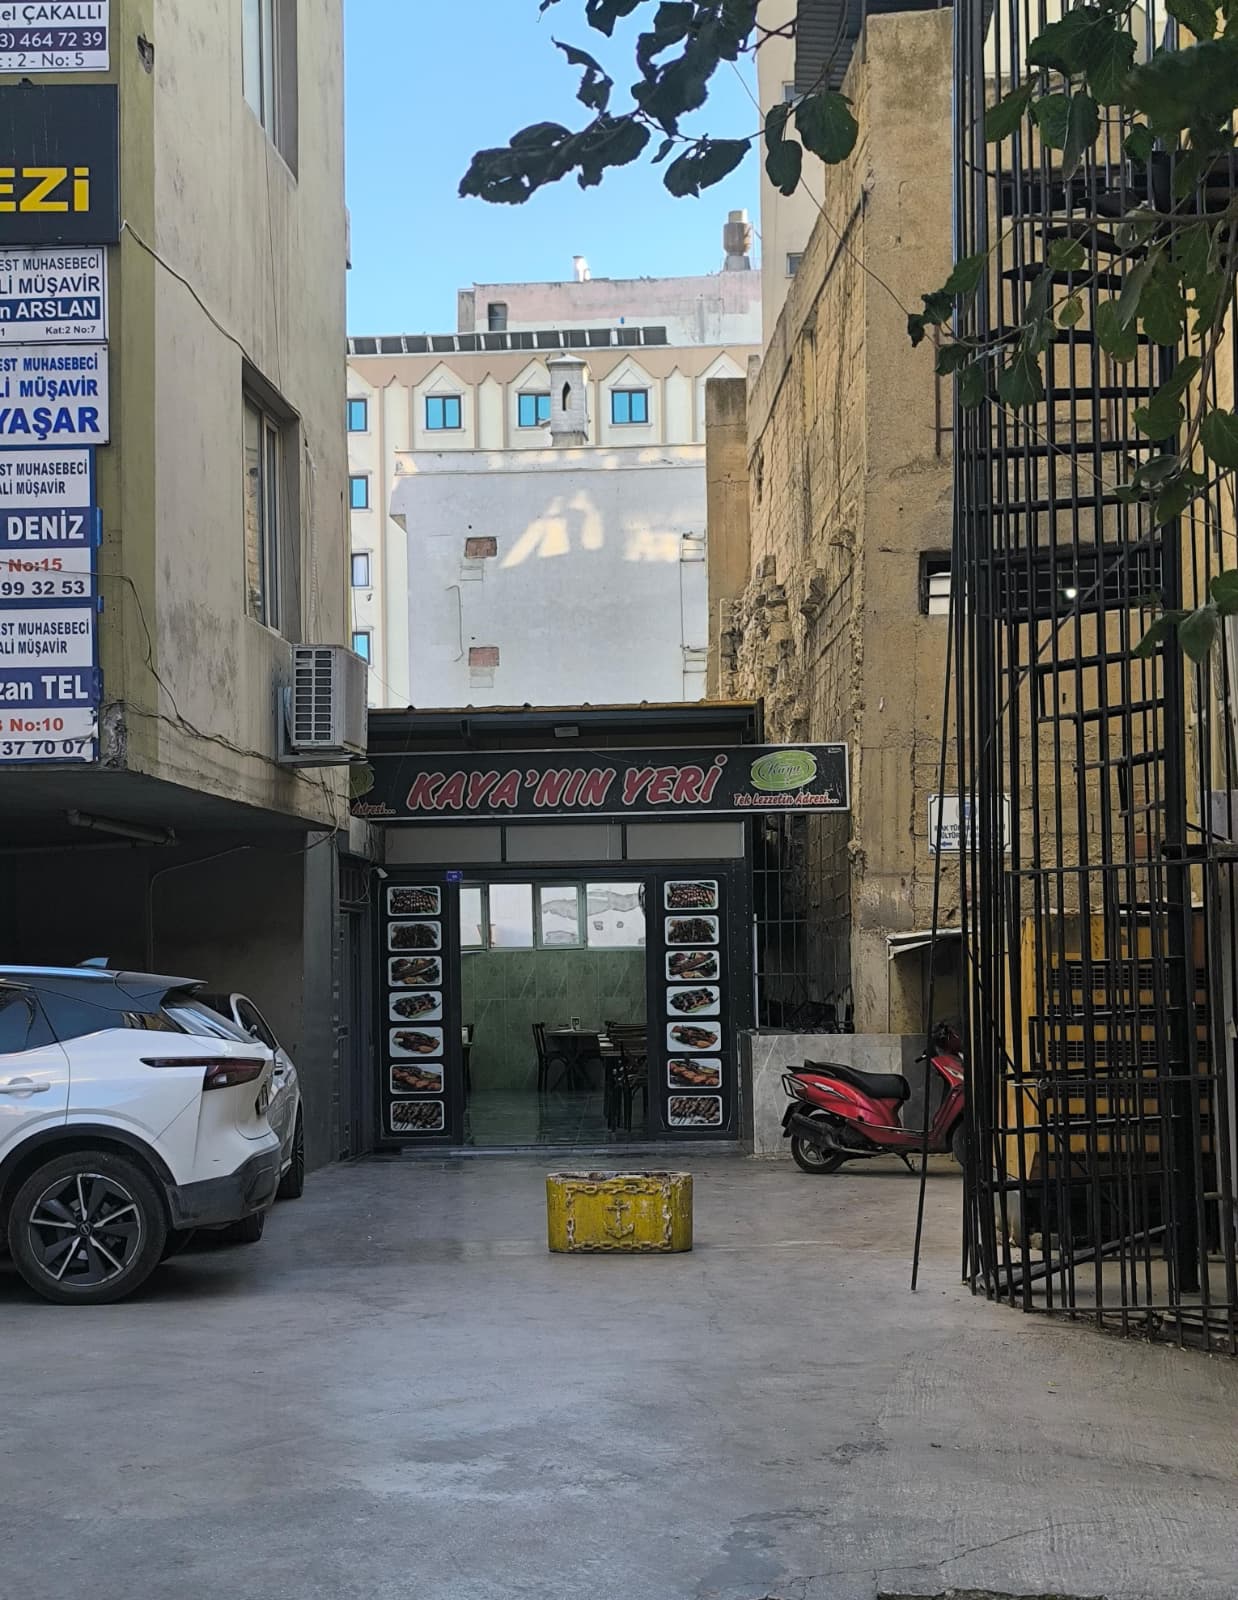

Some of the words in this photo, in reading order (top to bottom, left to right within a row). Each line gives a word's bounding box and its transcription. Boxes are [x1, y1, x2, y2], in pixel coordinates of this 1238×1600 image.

[22, 4, 102, 26] ÇAKALLI
[19, 32, 54, 47] 464
[58, 32, 77, 47] 72
[82, 31, 103, 47] 39
[22, 253, 99, 271] MUHASEBECİ
[19, 272, 101, 297] MÜŞAVİR
[16, 300, 96, 319] ARSLAN
[45, 325, 71, 335] Kat:2
[73, 325, 96, 335] No:7
[23, 352, 98, 371] MUHASEBECİ
[19, 374, 98, 402] MÜŞAVİR
[16, 458, 88, 477] MUHASEBECİ
[16, 477, 66, 498] MÜŞAVİR
[7, 509, 85, 541] DENİZ
[8, 557, 63, 573] No:15
[1, 581, 25, 596] 99
[31, 580, 55, 595] 32
[61, 580, 85, 595] 53
[18, 618, 89, 636] MUHASEBECİ
[18, 637, 68, 657] MÜŞAVİR
[41, 675, 89, 700] TEL
[10, 717, 64, 732] No:10
[2, 741, 26, 756] 37
[32, 740, 56, 755] 70
[62, 740, 86, 754] 07
[622, 753, 728, 805] YERİ
[733, 792, 752, 806] Tek
